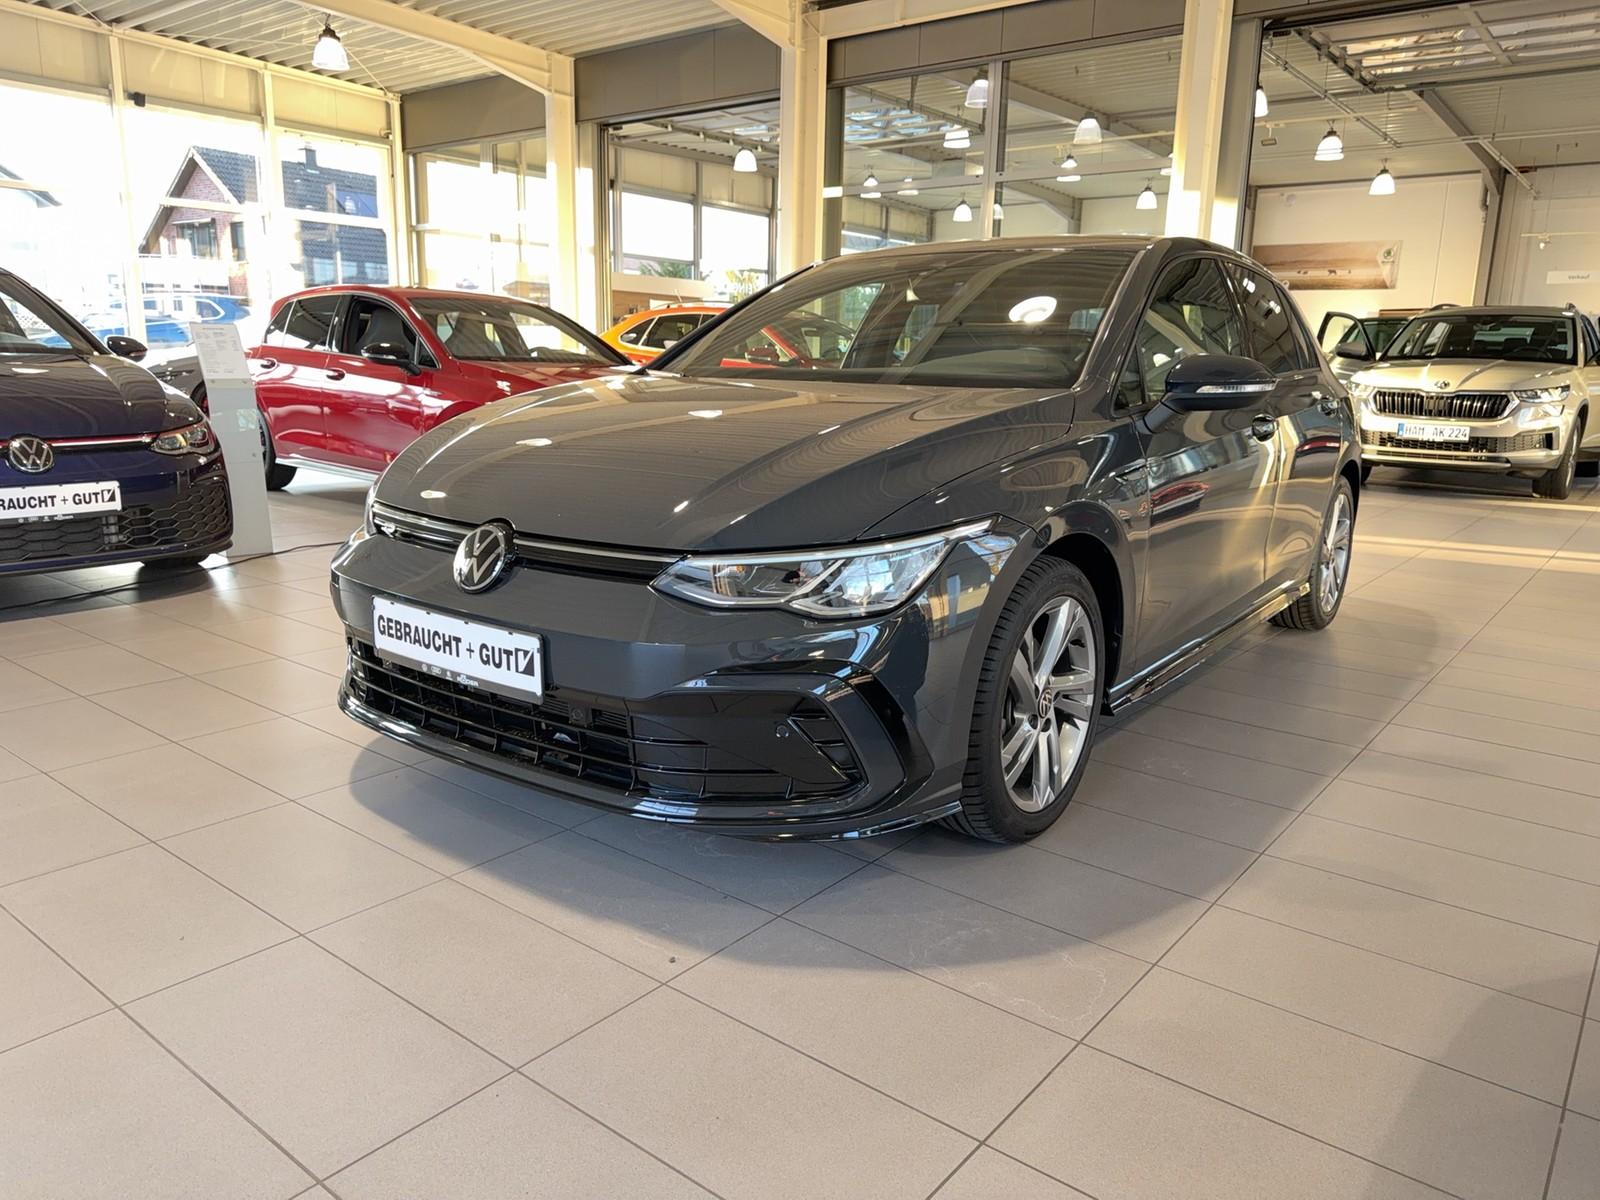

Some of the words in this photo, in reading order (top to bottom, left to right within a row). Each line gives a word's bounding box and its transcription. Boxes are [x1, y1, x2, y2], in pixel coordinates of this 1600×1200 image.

[1433, 427, 1445, 437] AK
[1448, 428, 1467, 438] 224
[73, 492, 100, 505] GUT
[377, 614, 462, 657] GEBRAUCHT
[479, 643, 514, 671] GUT
